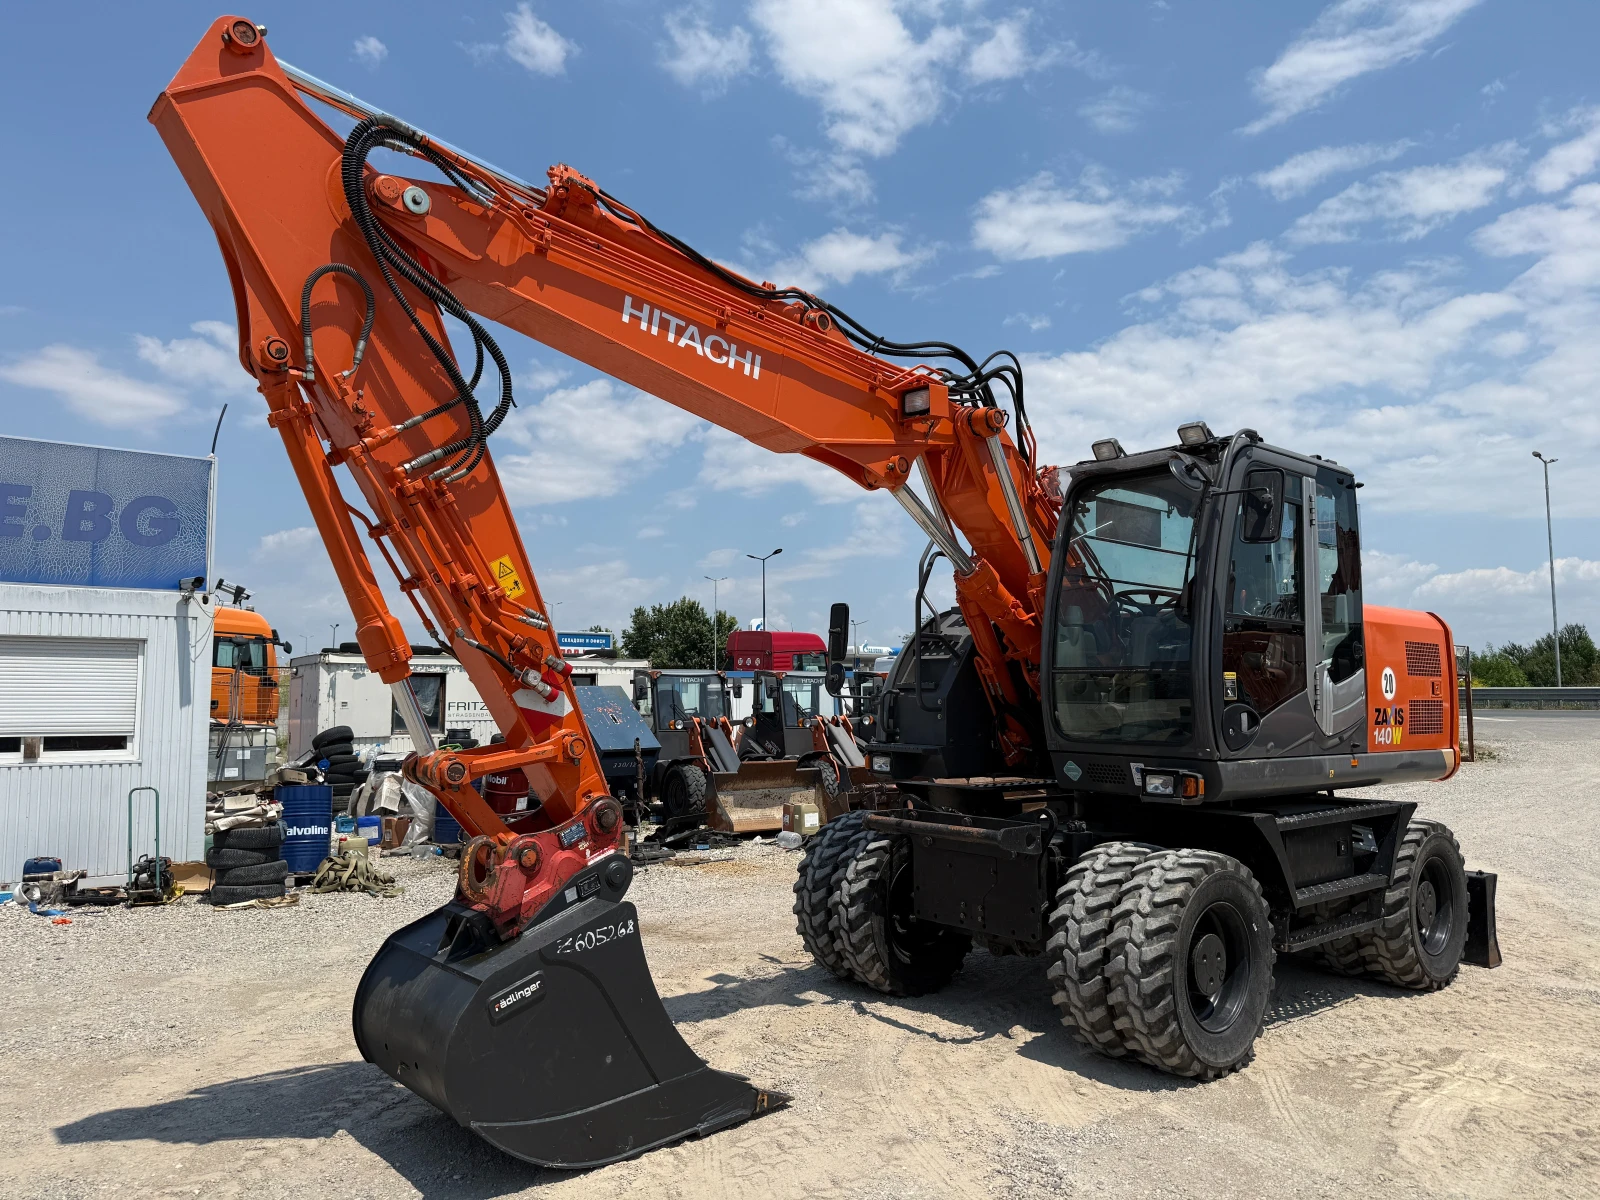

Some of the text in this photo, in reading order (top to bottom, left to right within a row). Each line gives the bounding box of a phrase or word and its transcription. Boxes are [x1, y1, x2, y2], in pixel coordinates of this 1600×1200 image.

[621, 294, 762, 381] HITACHI
[0, 482, 181, 547] E.BG
[1383, 672, 1394, 695] 20
[1374, 704, 1404, 726] ZAXIS
[1374, 727, 1403, 745] 140W
[487, 774, 507, 785] Mobil
[286, 825, 329, 836] alvoline
[494, 980, 542, 1012] rädlinger
